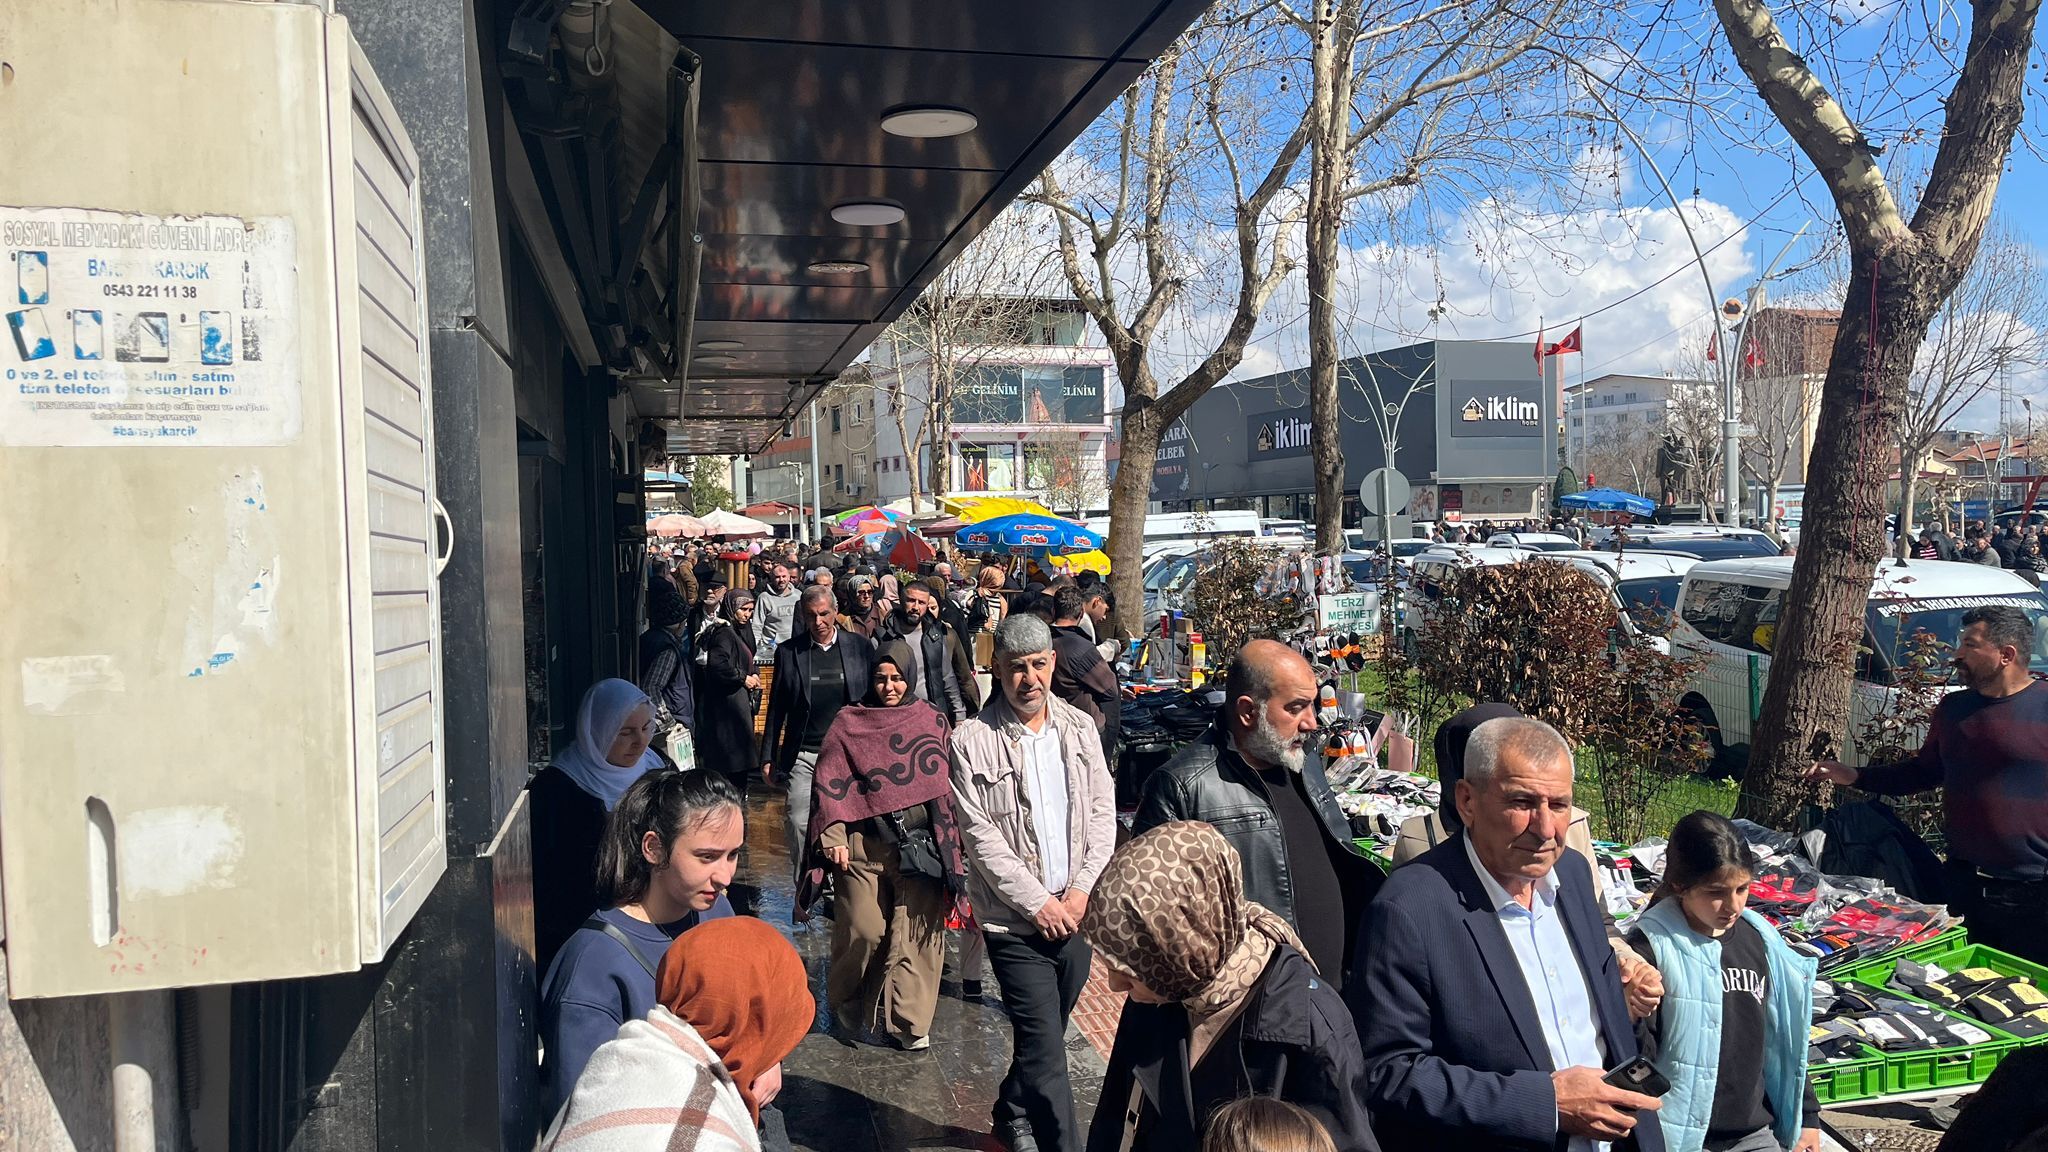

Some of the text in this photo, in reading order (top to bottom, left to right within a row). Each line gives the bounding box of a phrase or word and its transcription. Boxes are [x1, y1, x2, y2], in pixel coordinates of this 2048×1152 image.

[4, 220, 60, 247] SOSYAL
[148, 221, 210, 251] GÜVENLİ
[103, 284, 197, 298] 0543 221 11 38
[44, 369, 58, 380] 2.
[63, 369, 78, 380] el
[55, 383, 111, 394] telefon
[1486, 396, 1539, 420] iklim
[1335, 596, 1365, 607] TERZİ
[1328, 610, 1373, 620] MEHMET
